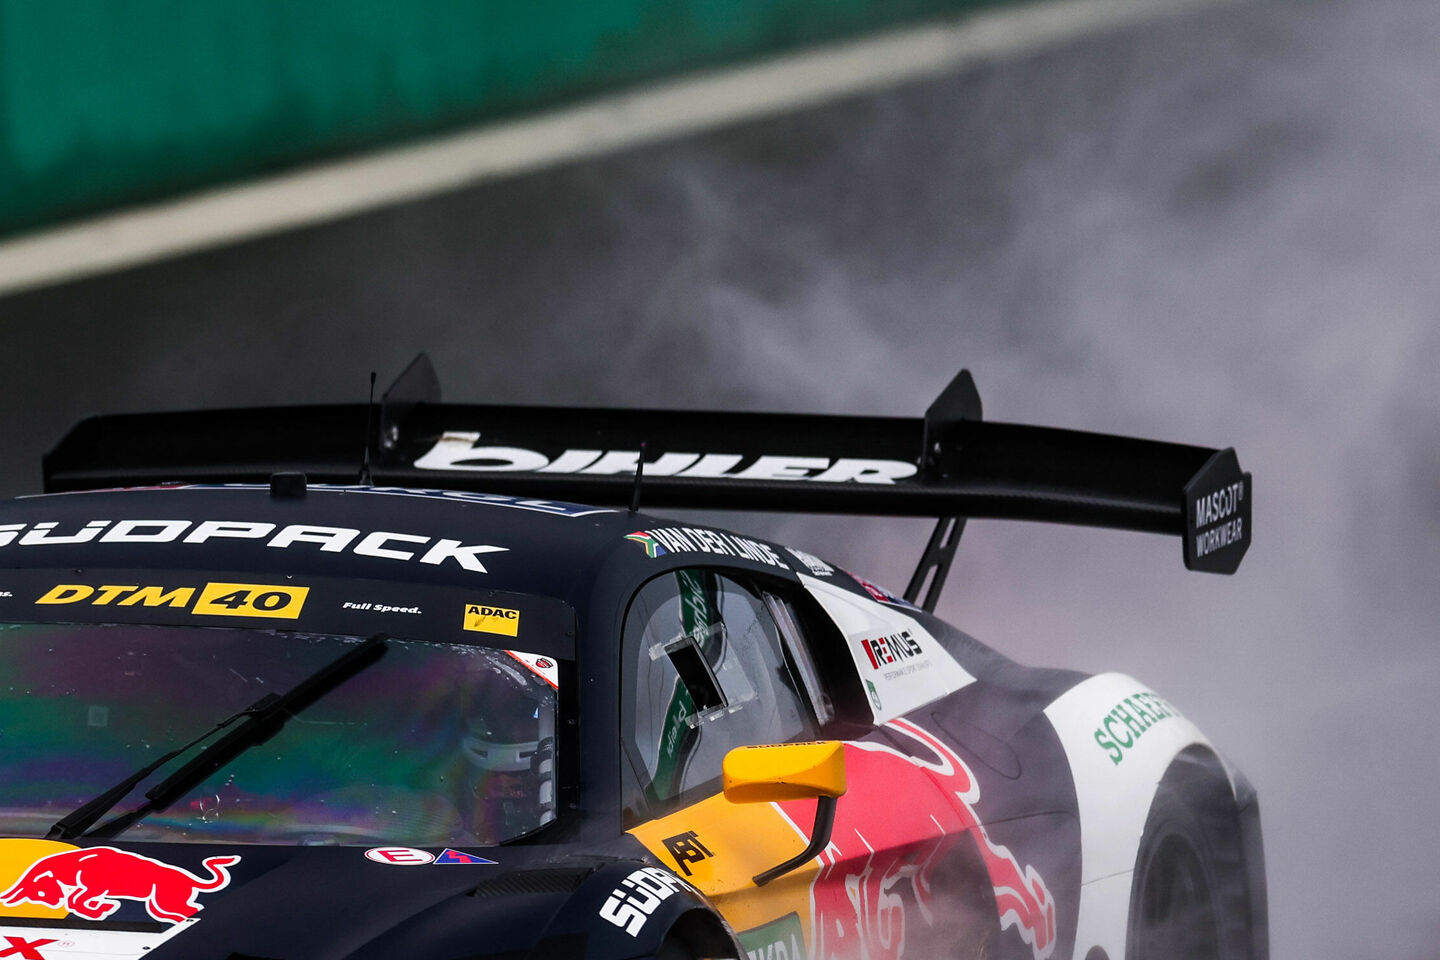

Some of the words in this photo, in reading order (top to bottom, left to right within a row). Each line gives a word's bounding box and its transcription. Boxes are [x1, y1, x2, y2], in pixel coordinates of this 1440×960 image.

[1196, 484, 1238, 528] MASCOT
[645, 527, 698, 553] VAN
[729, 535, 790, 570] LINDE
[1196, 517, 1242, 557] WORKWEAR
[35, 584, 196, 608] DTM
[209, 590, 292, 611] 40
[342, 602, 371, 610] Full
[373, 604, 422, 614] Speed.
[468, 606, 518, 620] ADAC
[870, 630, 923, 667] REMUS
[662, 830, 715, 877] ABT
